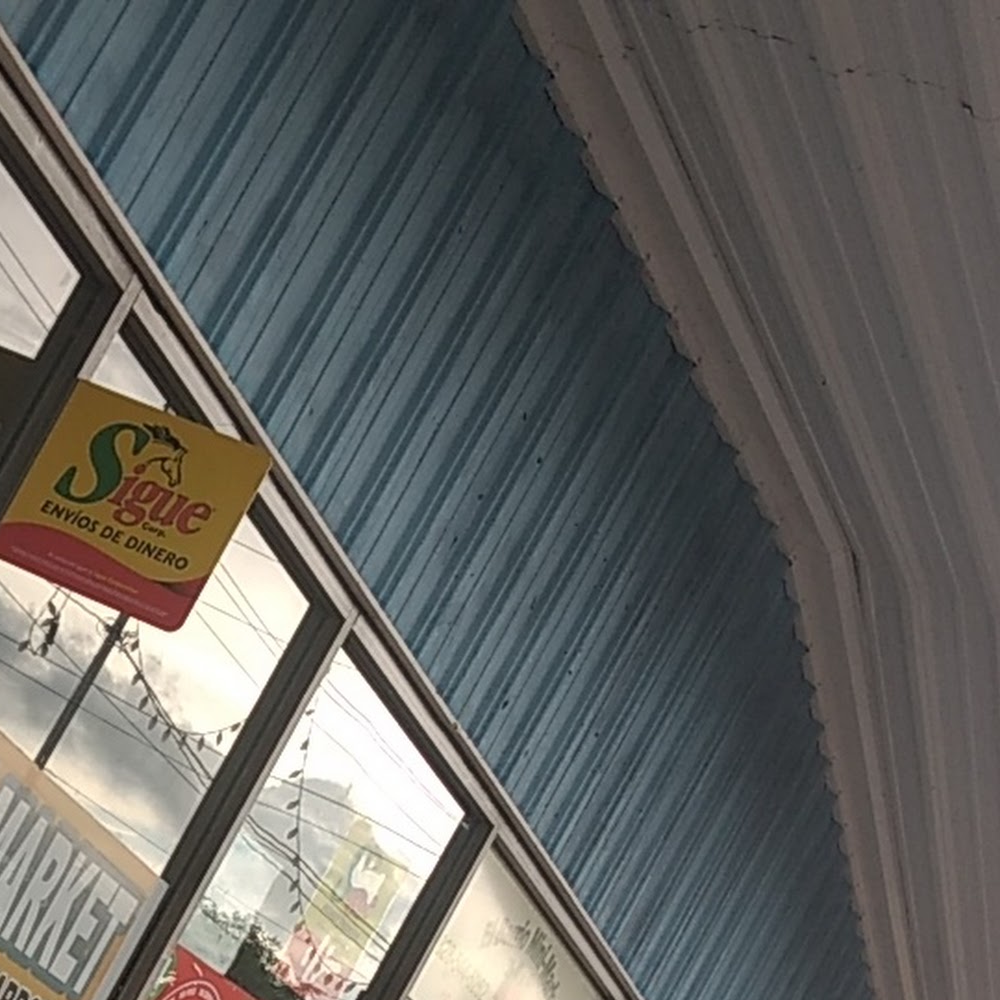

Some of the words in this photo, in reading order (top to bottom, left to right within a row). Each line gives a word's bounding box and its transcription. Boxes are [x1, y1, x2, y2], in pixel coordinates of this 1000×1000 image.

[54, 422, 212, 535] Sigue
[40, 499, 99, 533] ENVÍOS
[99, 525, 123, 544] DE
[124, 534, 189, 571] DINERO
